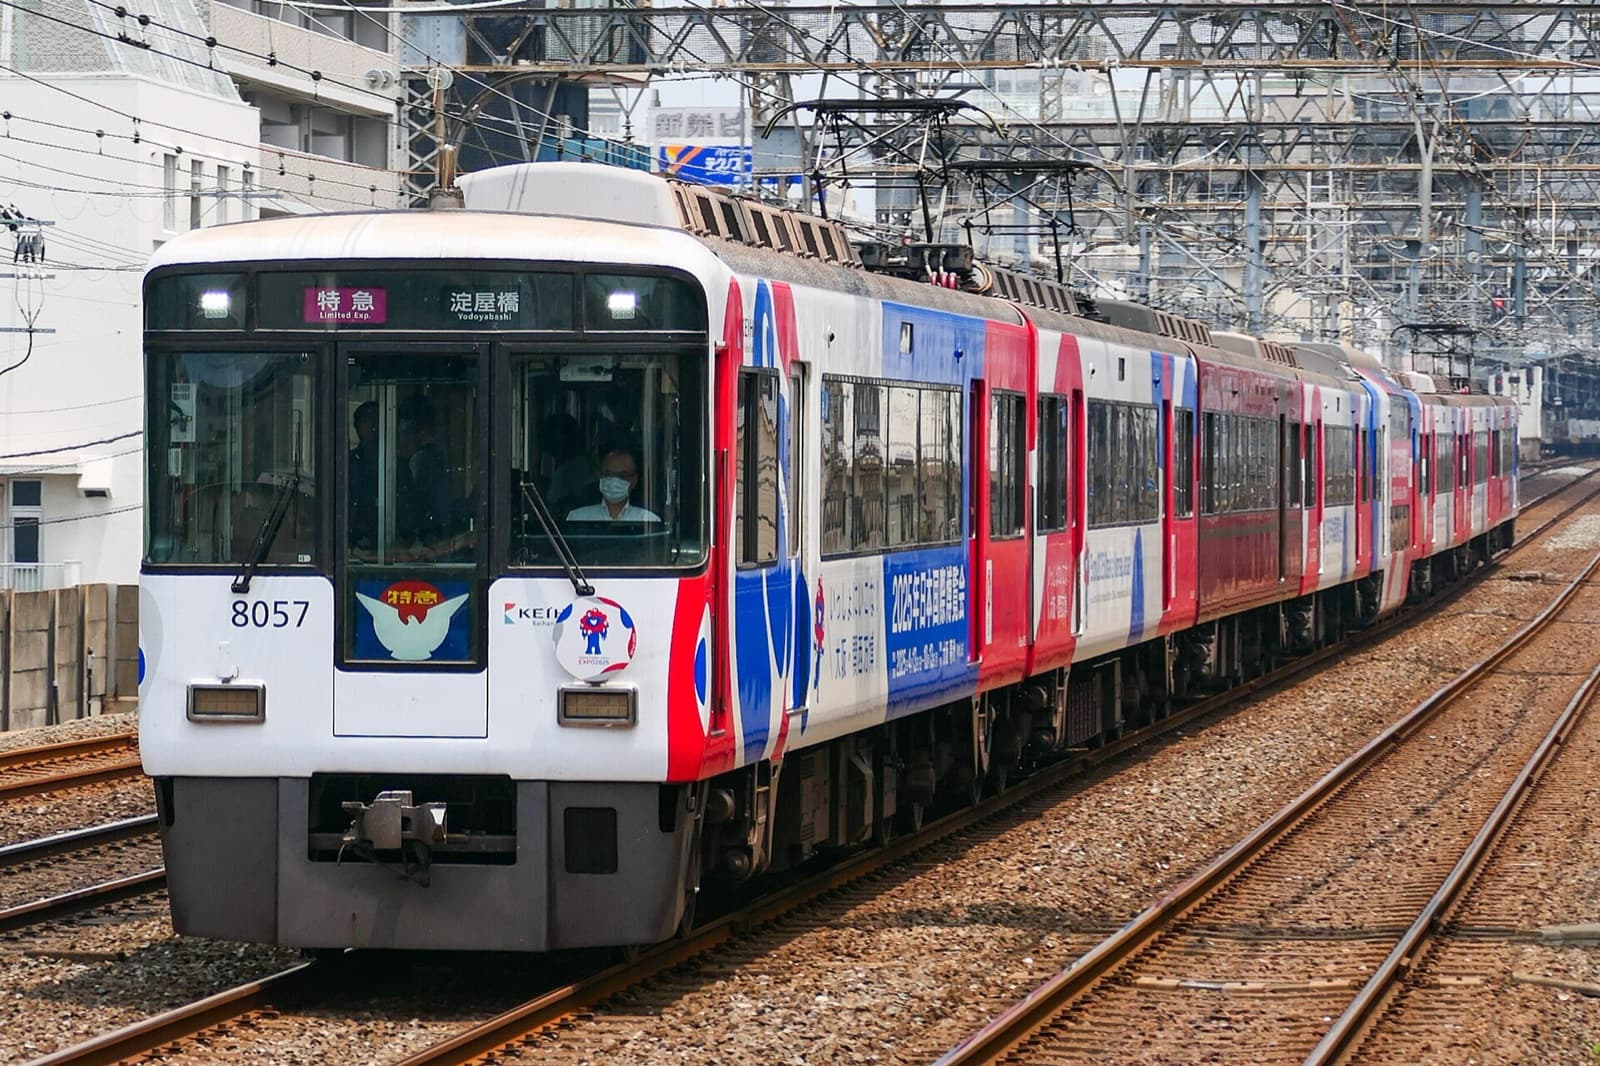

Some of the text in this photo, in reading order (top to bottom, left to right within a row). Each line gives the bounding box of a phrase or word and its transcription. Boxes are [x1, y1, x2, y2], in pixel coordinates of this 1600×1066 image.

[317, 290, 375, 311] 特急
[450, 292, 519, 313] 淀屋橋
[319, 311, 371, 321] Limited Exp.
[458, 313, 512, 321] Yodoyabashi
[387, 590, 438, 605] 特急
[231, 600, 310, 629] 8057
